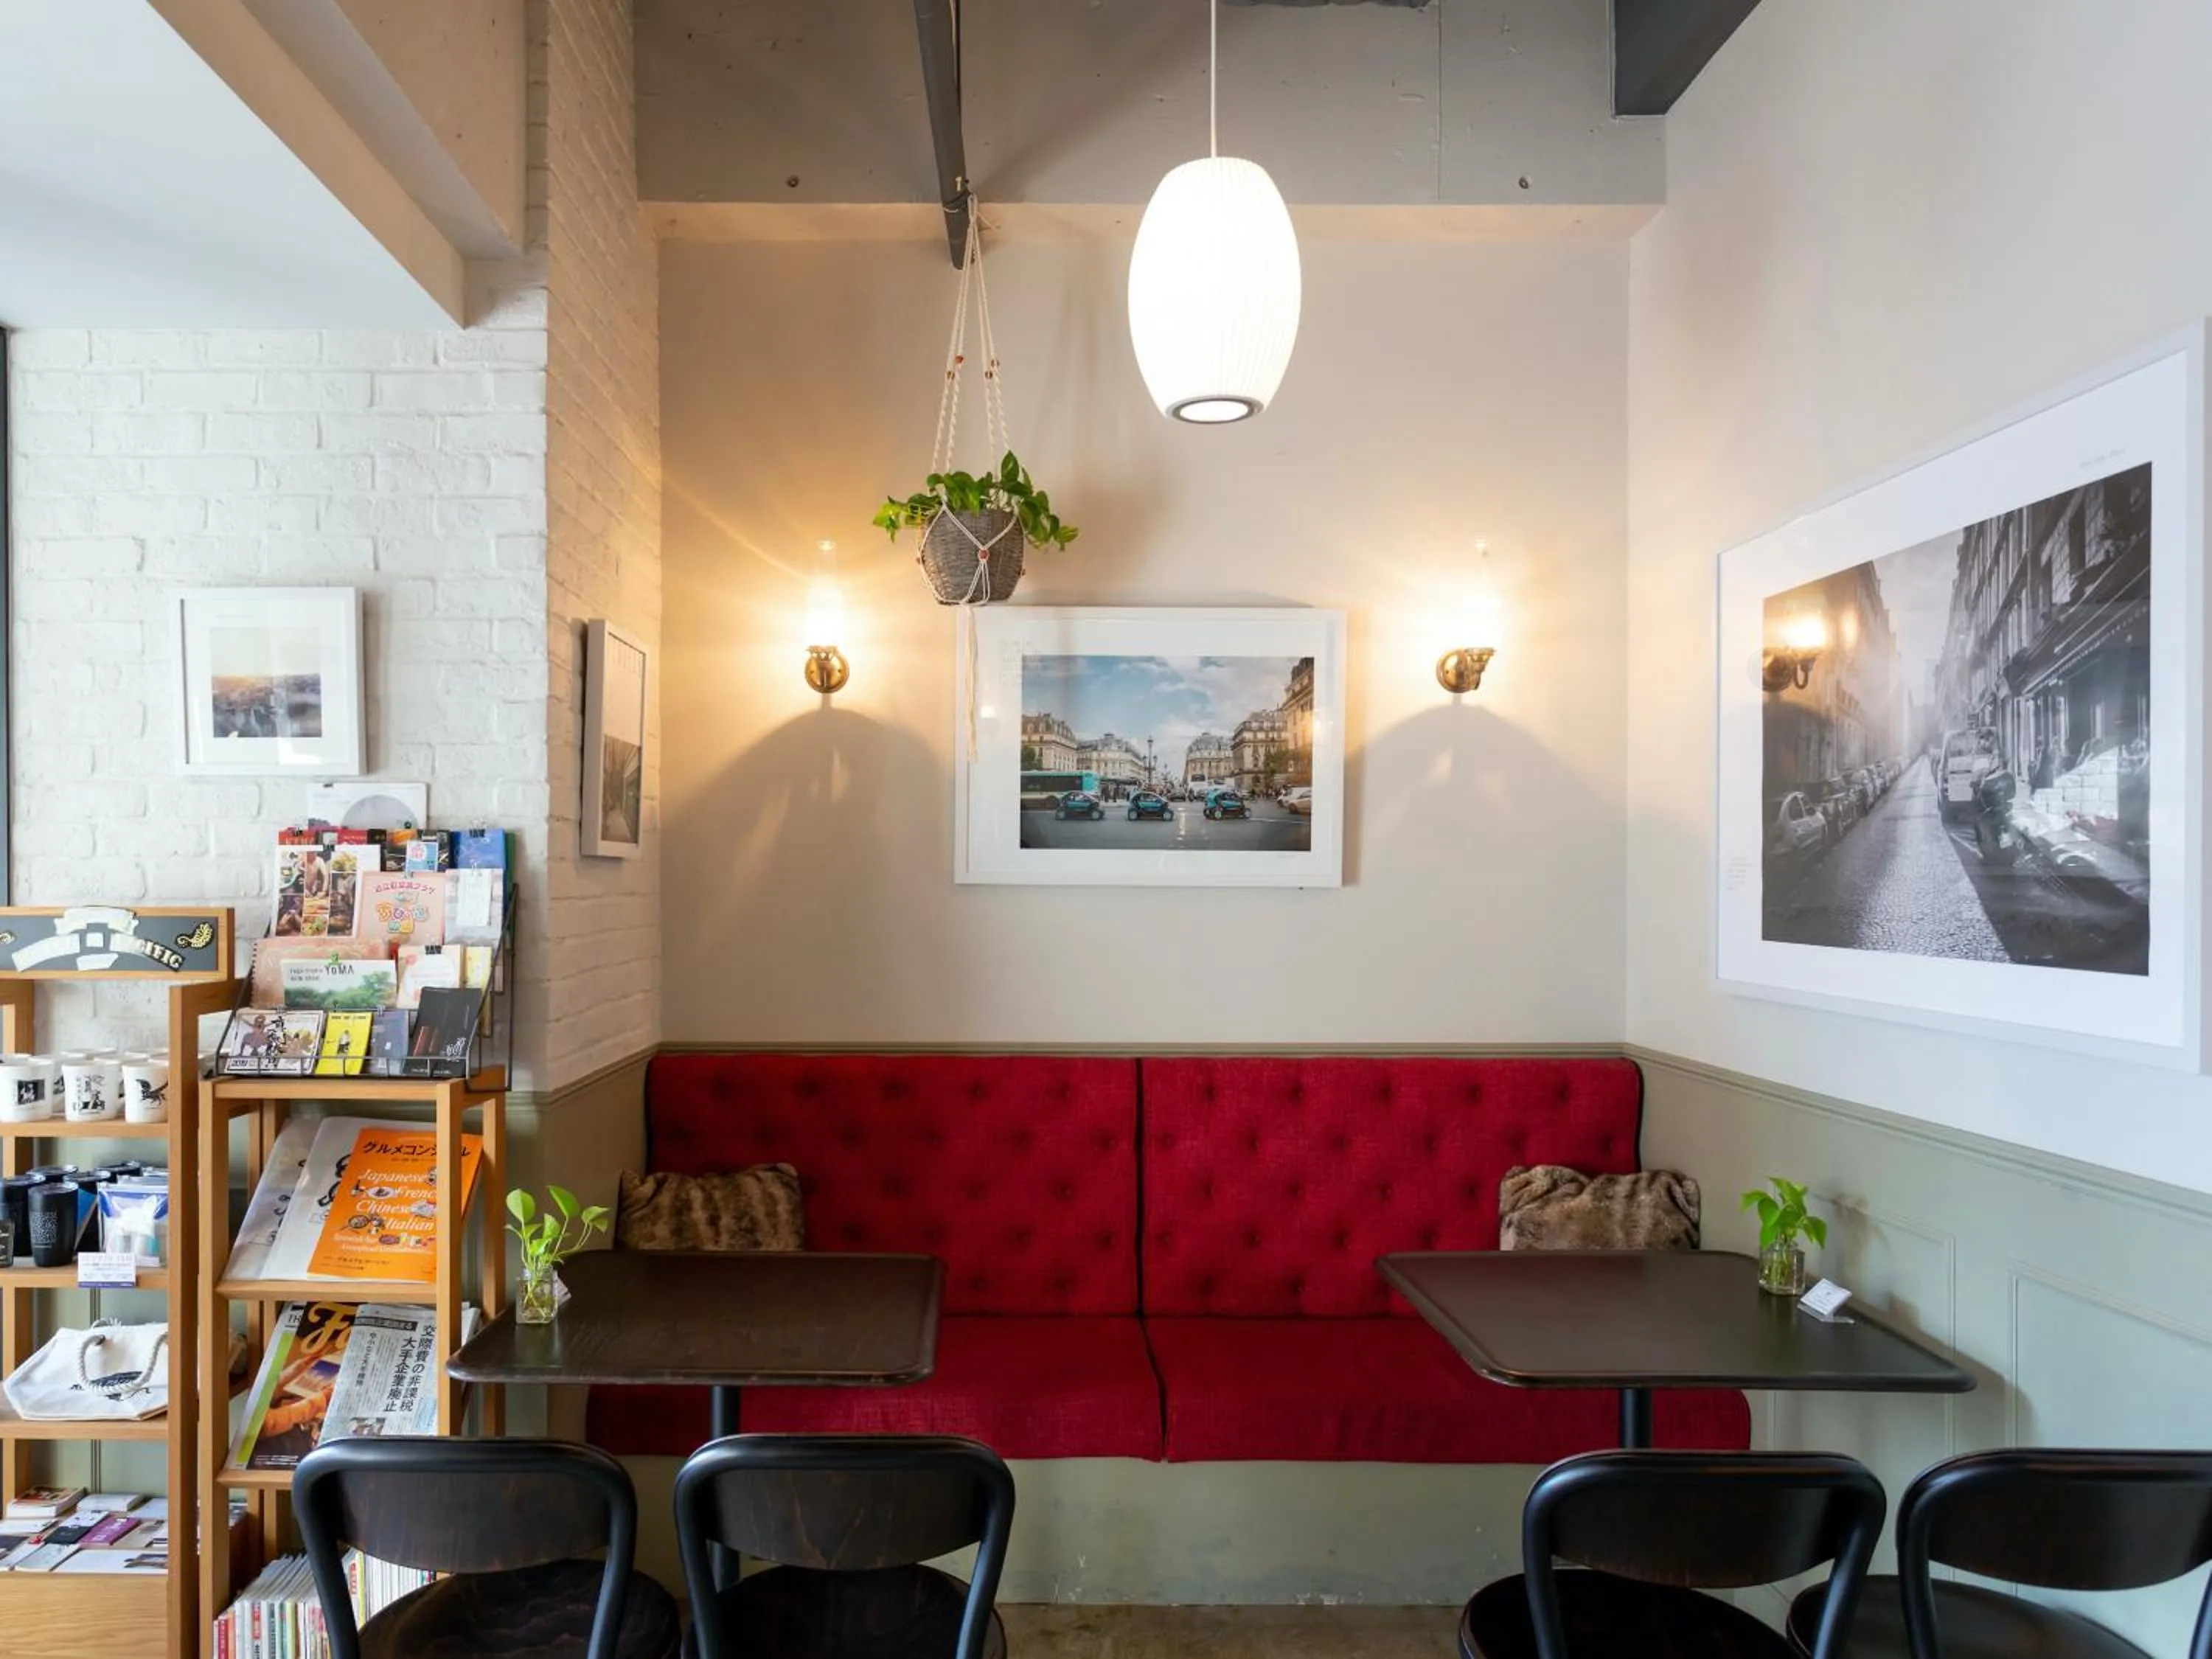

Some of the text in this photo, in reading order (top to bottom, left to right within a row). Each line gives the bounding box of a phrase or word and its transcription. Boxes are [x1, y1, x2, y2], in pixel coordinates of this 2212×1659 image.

[358, 1169, 427, 1184] Japanese
[395, 1186, 436, 1198] Frenc
[383, 1336, 417, 1412] 大手企業廃止
